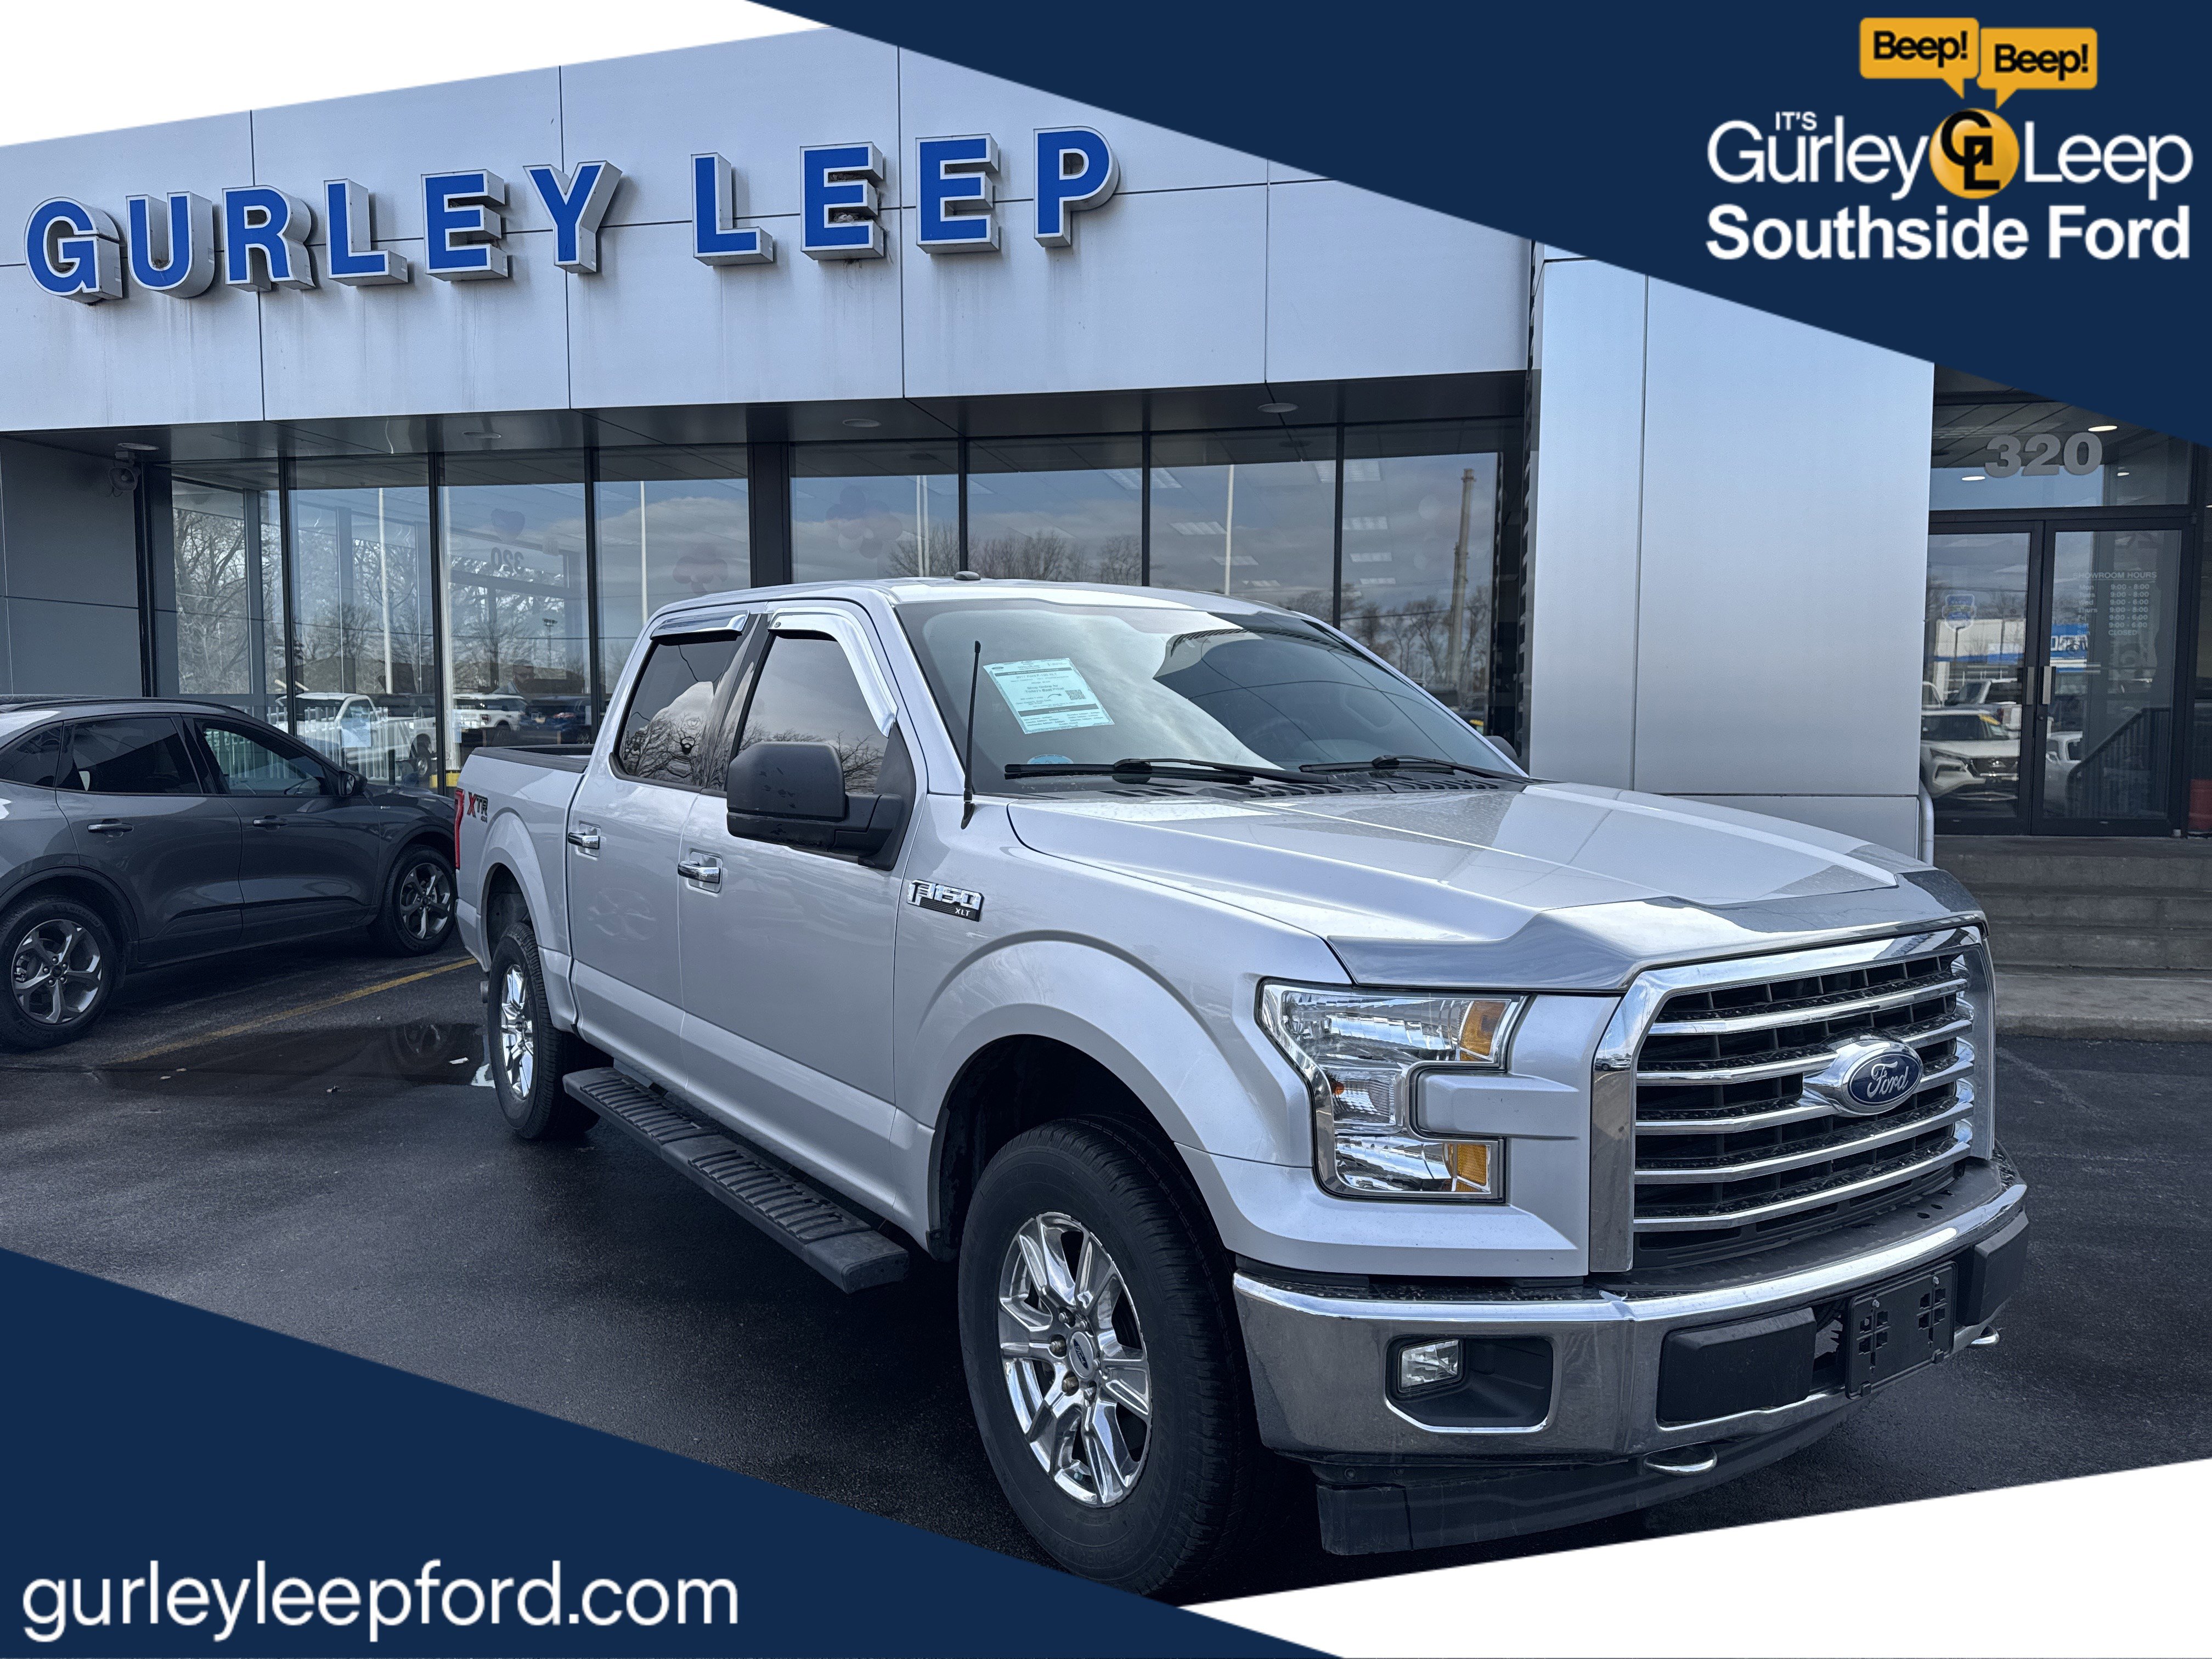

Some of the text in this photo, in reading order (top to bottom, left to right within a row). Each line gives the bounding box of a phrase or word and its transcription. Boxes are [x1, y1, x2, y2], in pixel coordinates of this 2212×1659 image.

[24, 126, 1120, 303] GURLEY LEEP
[1984, 432, 2103, 478] 320
[467, 791, 488, 818] XTR
[955, 907, 971, 917] XLT
[1866, 1060, 1909, 1099] Ford
